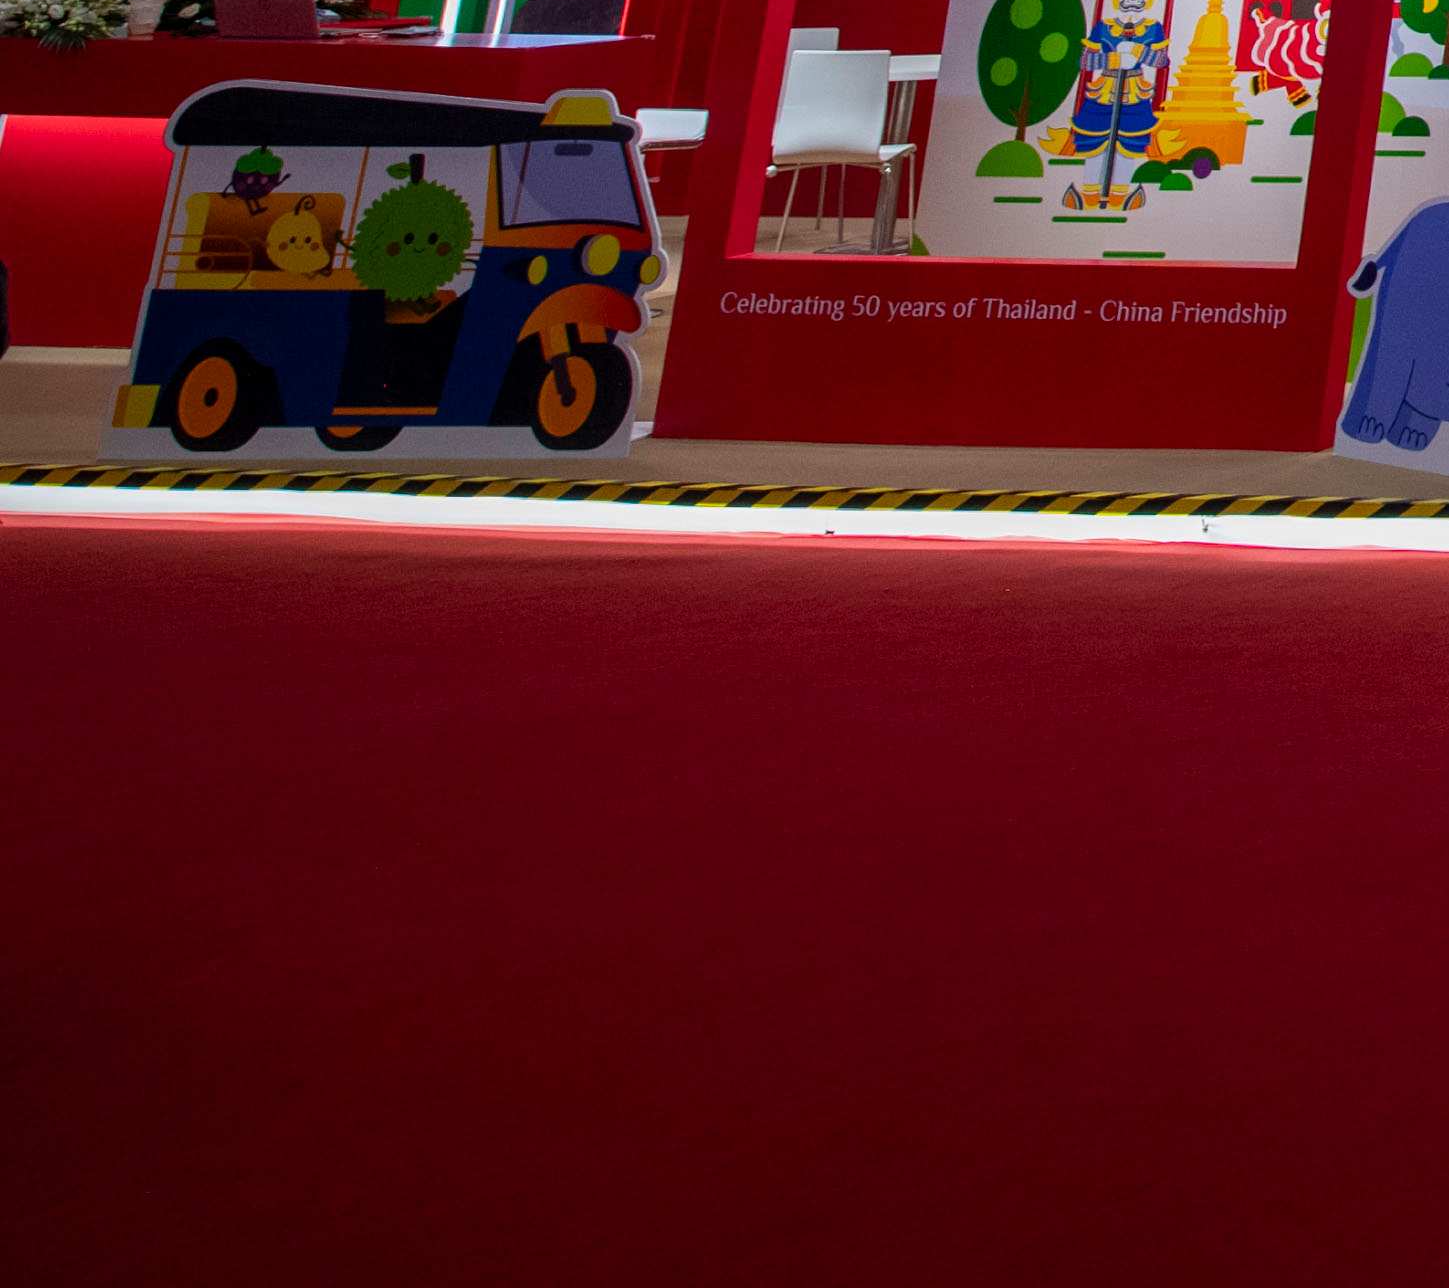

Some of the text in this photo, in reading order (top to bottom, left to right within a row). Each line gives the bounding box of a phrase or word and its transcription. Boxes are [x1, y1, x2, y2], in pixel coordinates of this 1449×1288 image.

[719, 291, 845, 323] Celebrating
[851, 294, 881, 318] 50
[887, 299, 946, 323] years
[953, 296, 978, 320] of
[982, 297, 1077, 322] Thailand
[1099, 299, 1163, 323] China
[1170, 300, 1288, 329] Friendship
